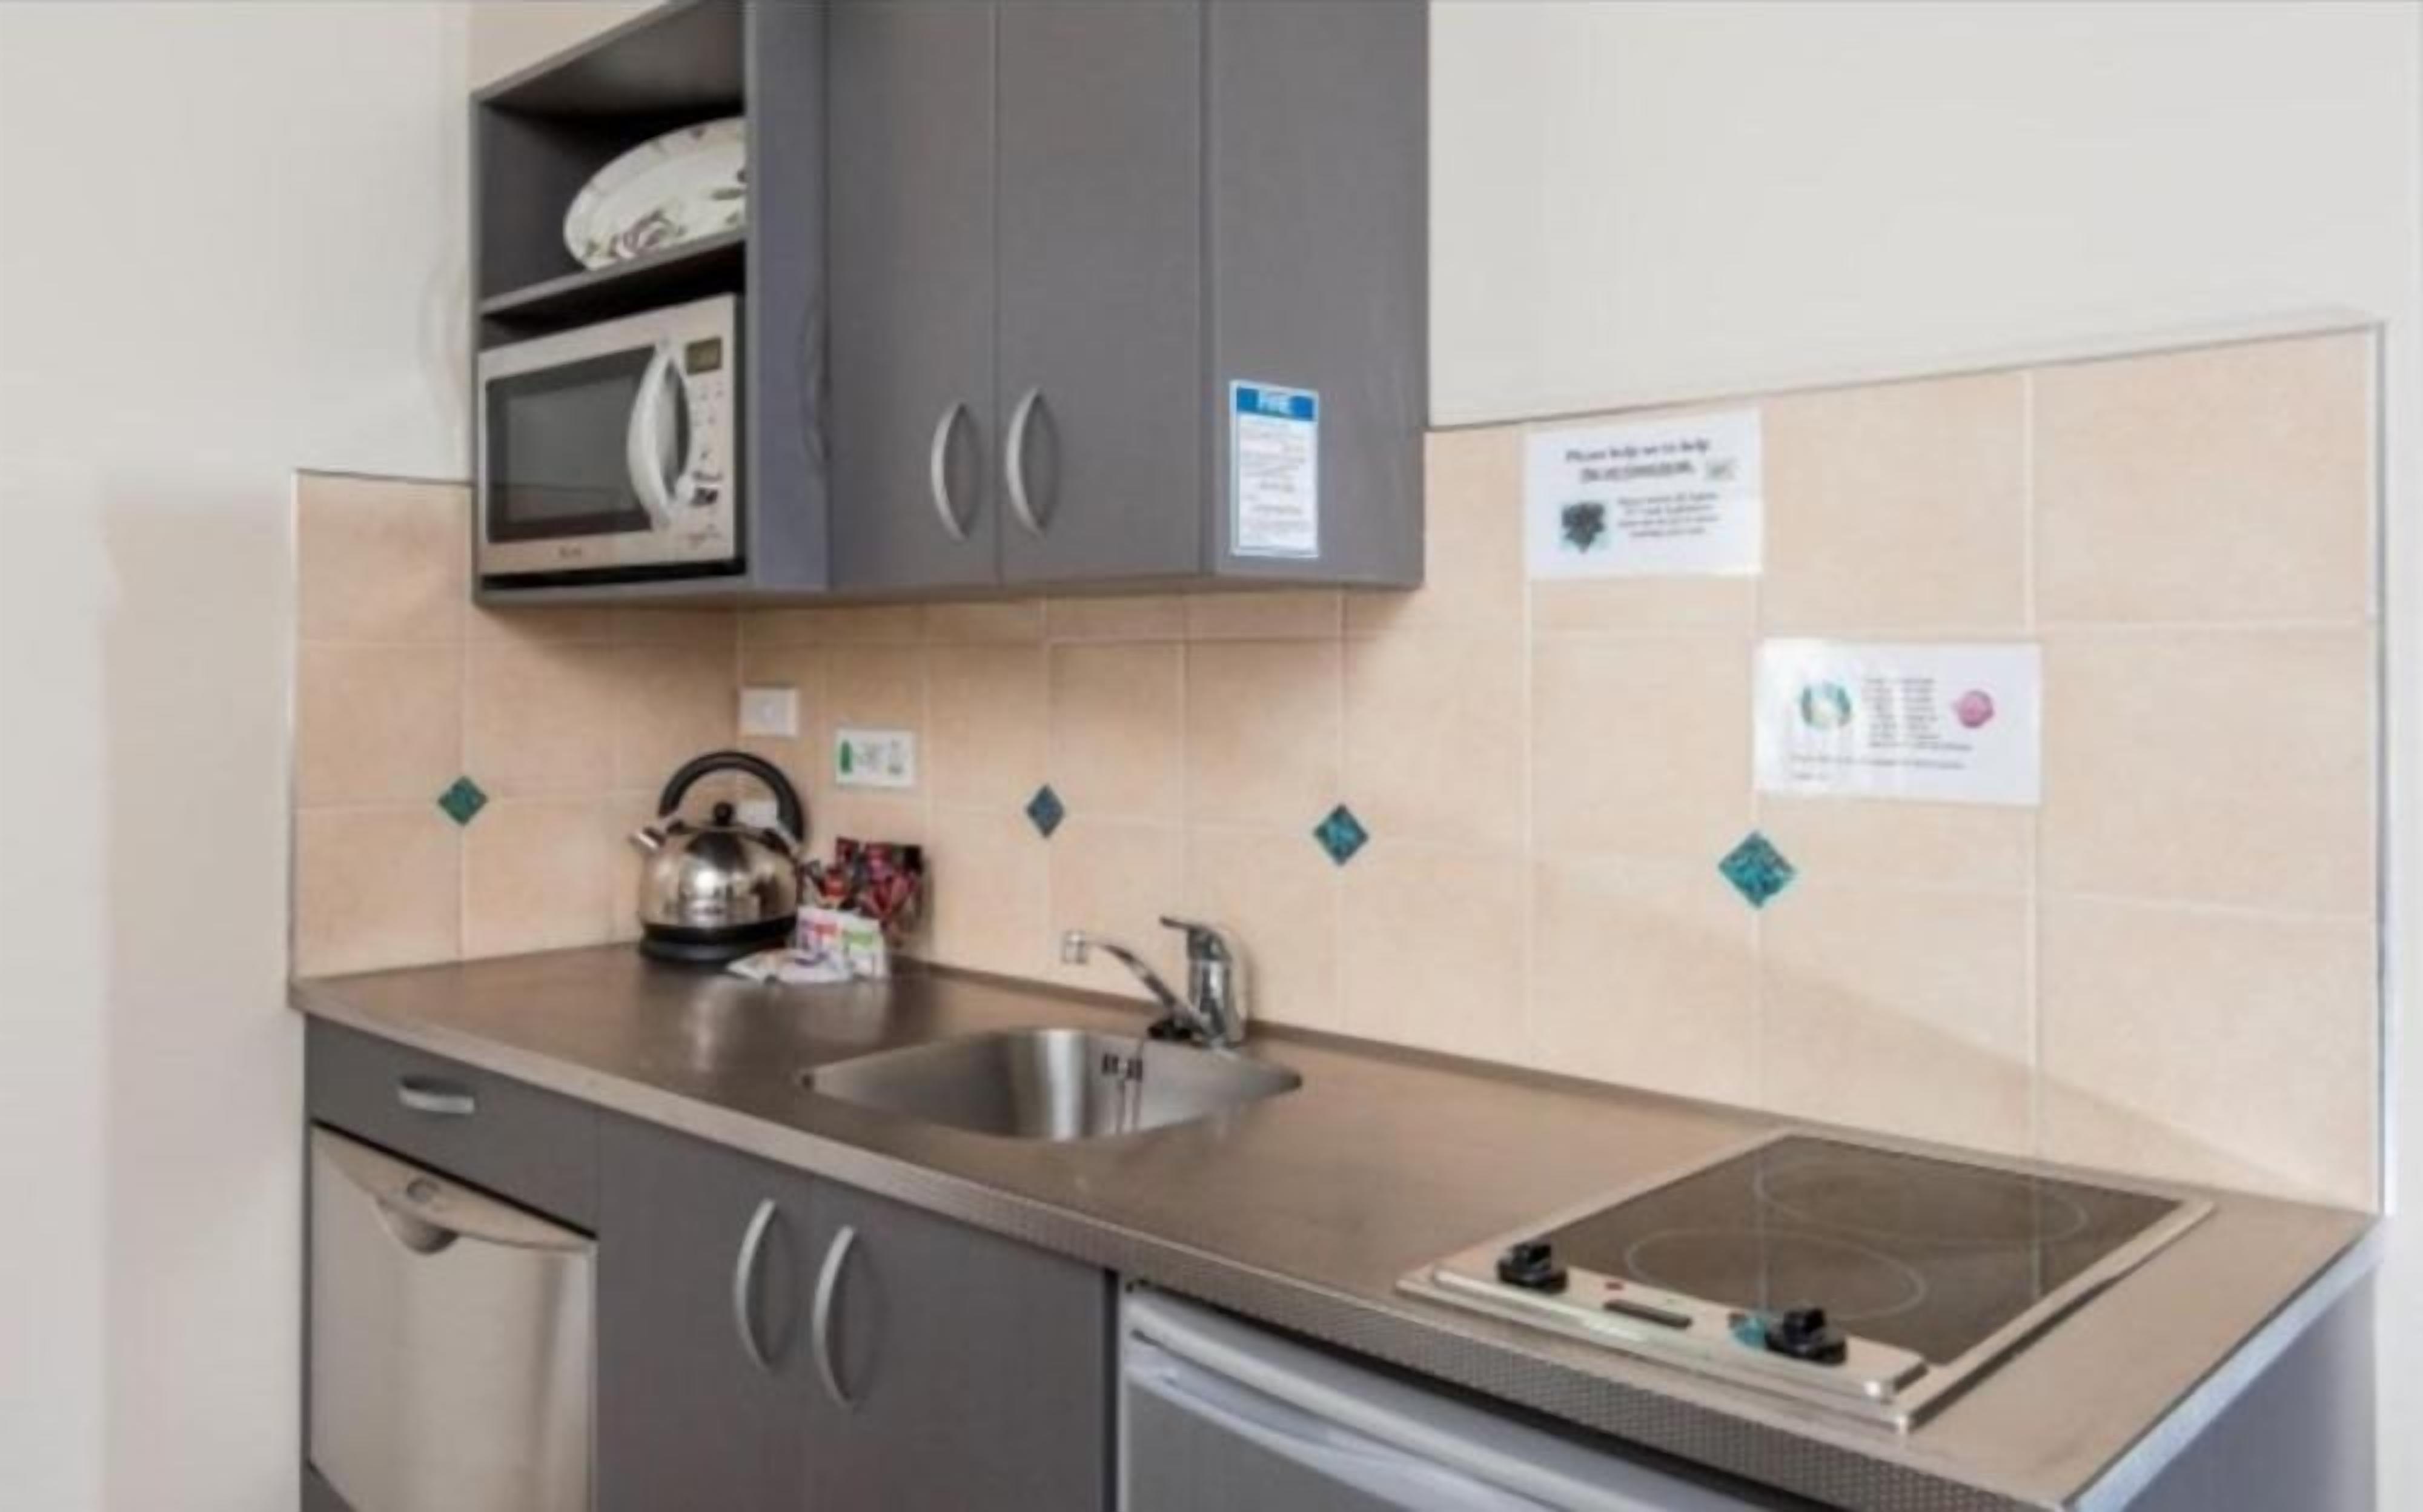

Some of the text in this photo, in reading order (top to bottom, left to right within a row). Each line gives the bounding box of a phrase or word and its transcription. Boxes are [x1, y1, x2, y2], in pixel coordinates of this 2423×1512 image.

[1258, 390, 1291, 416] FIRE
[1565, 448, 1606, 463] Please
[1609, 445, 1638, 459] help
[1680, 438, 1711, 454] help
